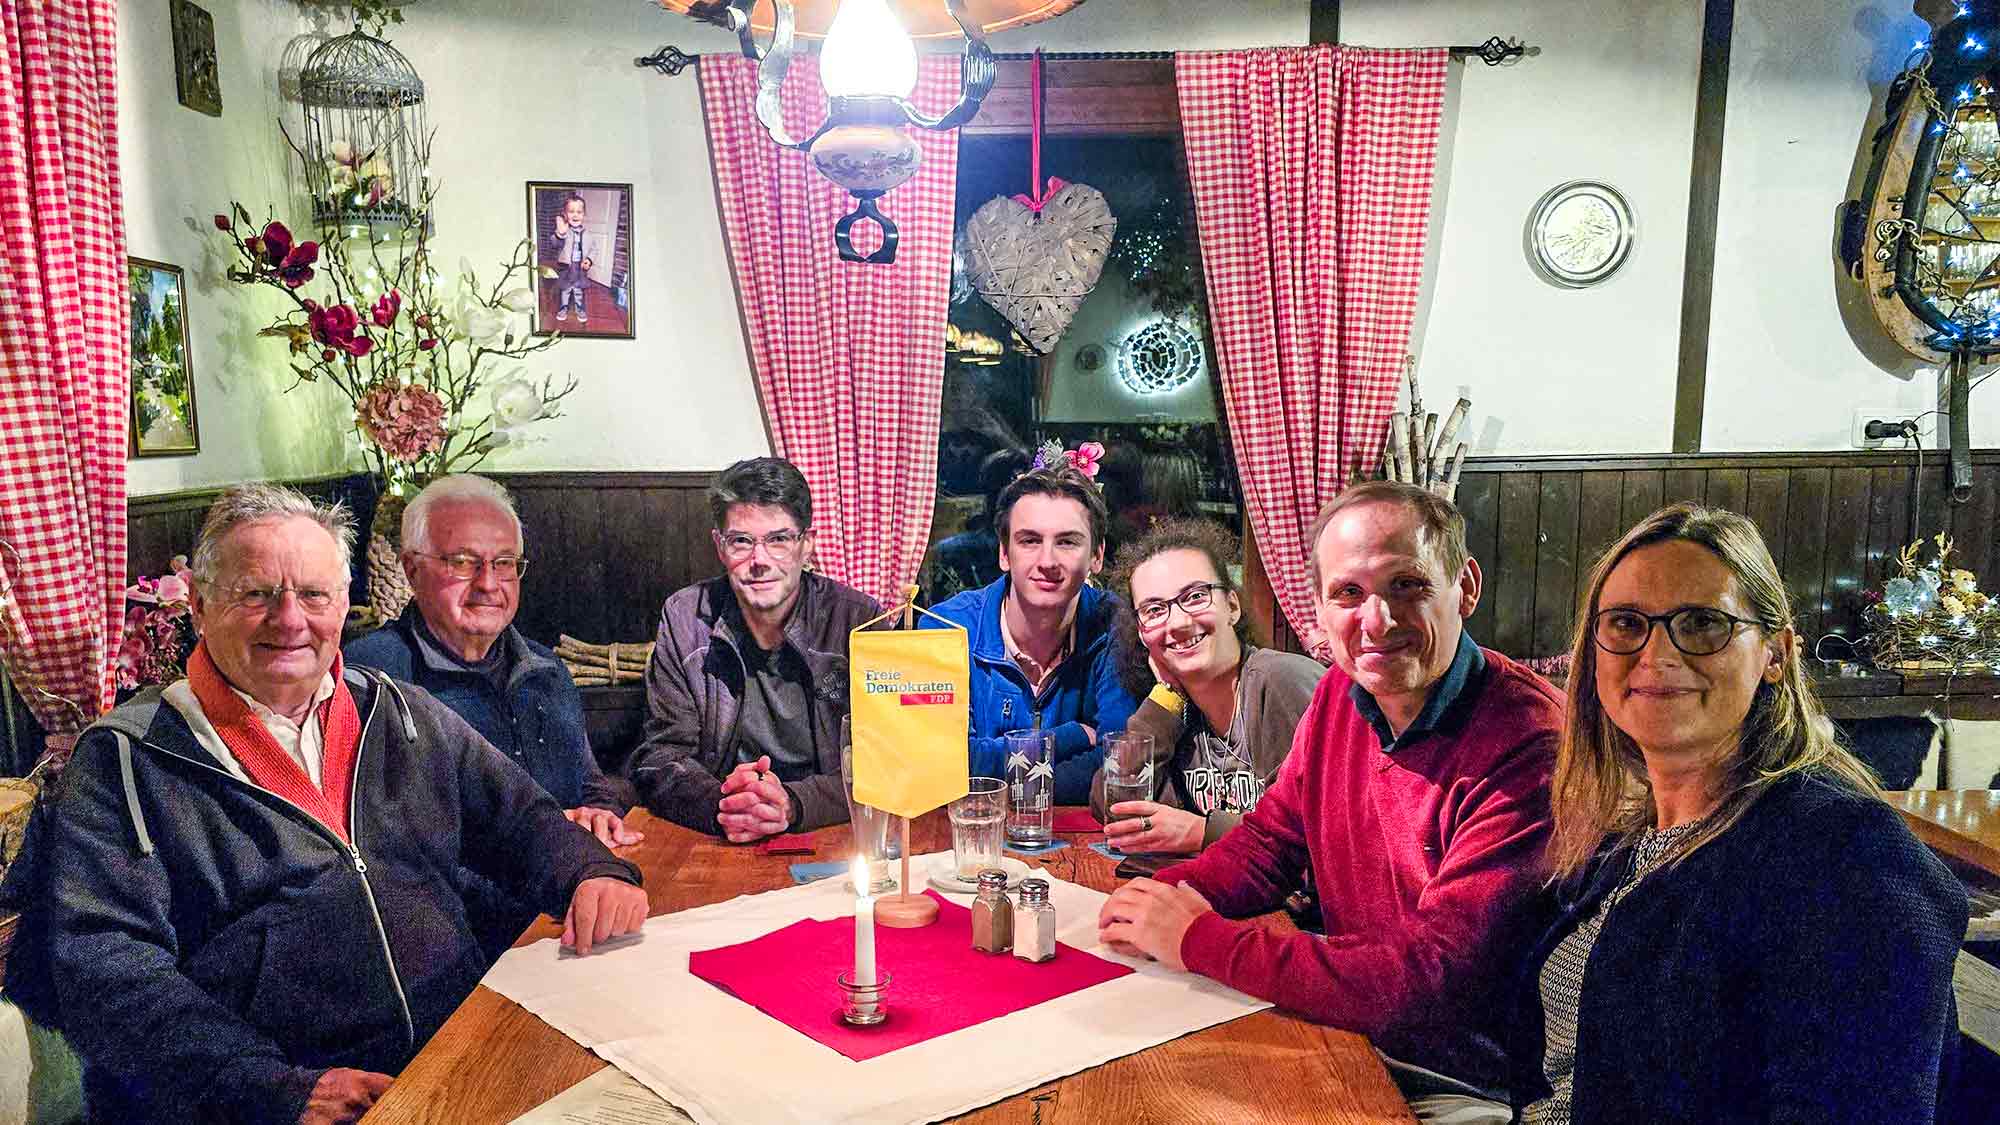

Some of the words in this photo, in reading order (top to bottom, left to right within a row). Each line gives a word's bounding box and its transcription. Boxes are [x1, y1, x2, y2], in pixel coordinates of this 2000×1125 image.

[866, 669, 901, 681] Freie
[866, 681, 954, 694] Demokraten
[930, 694, 951, 704] FDP
